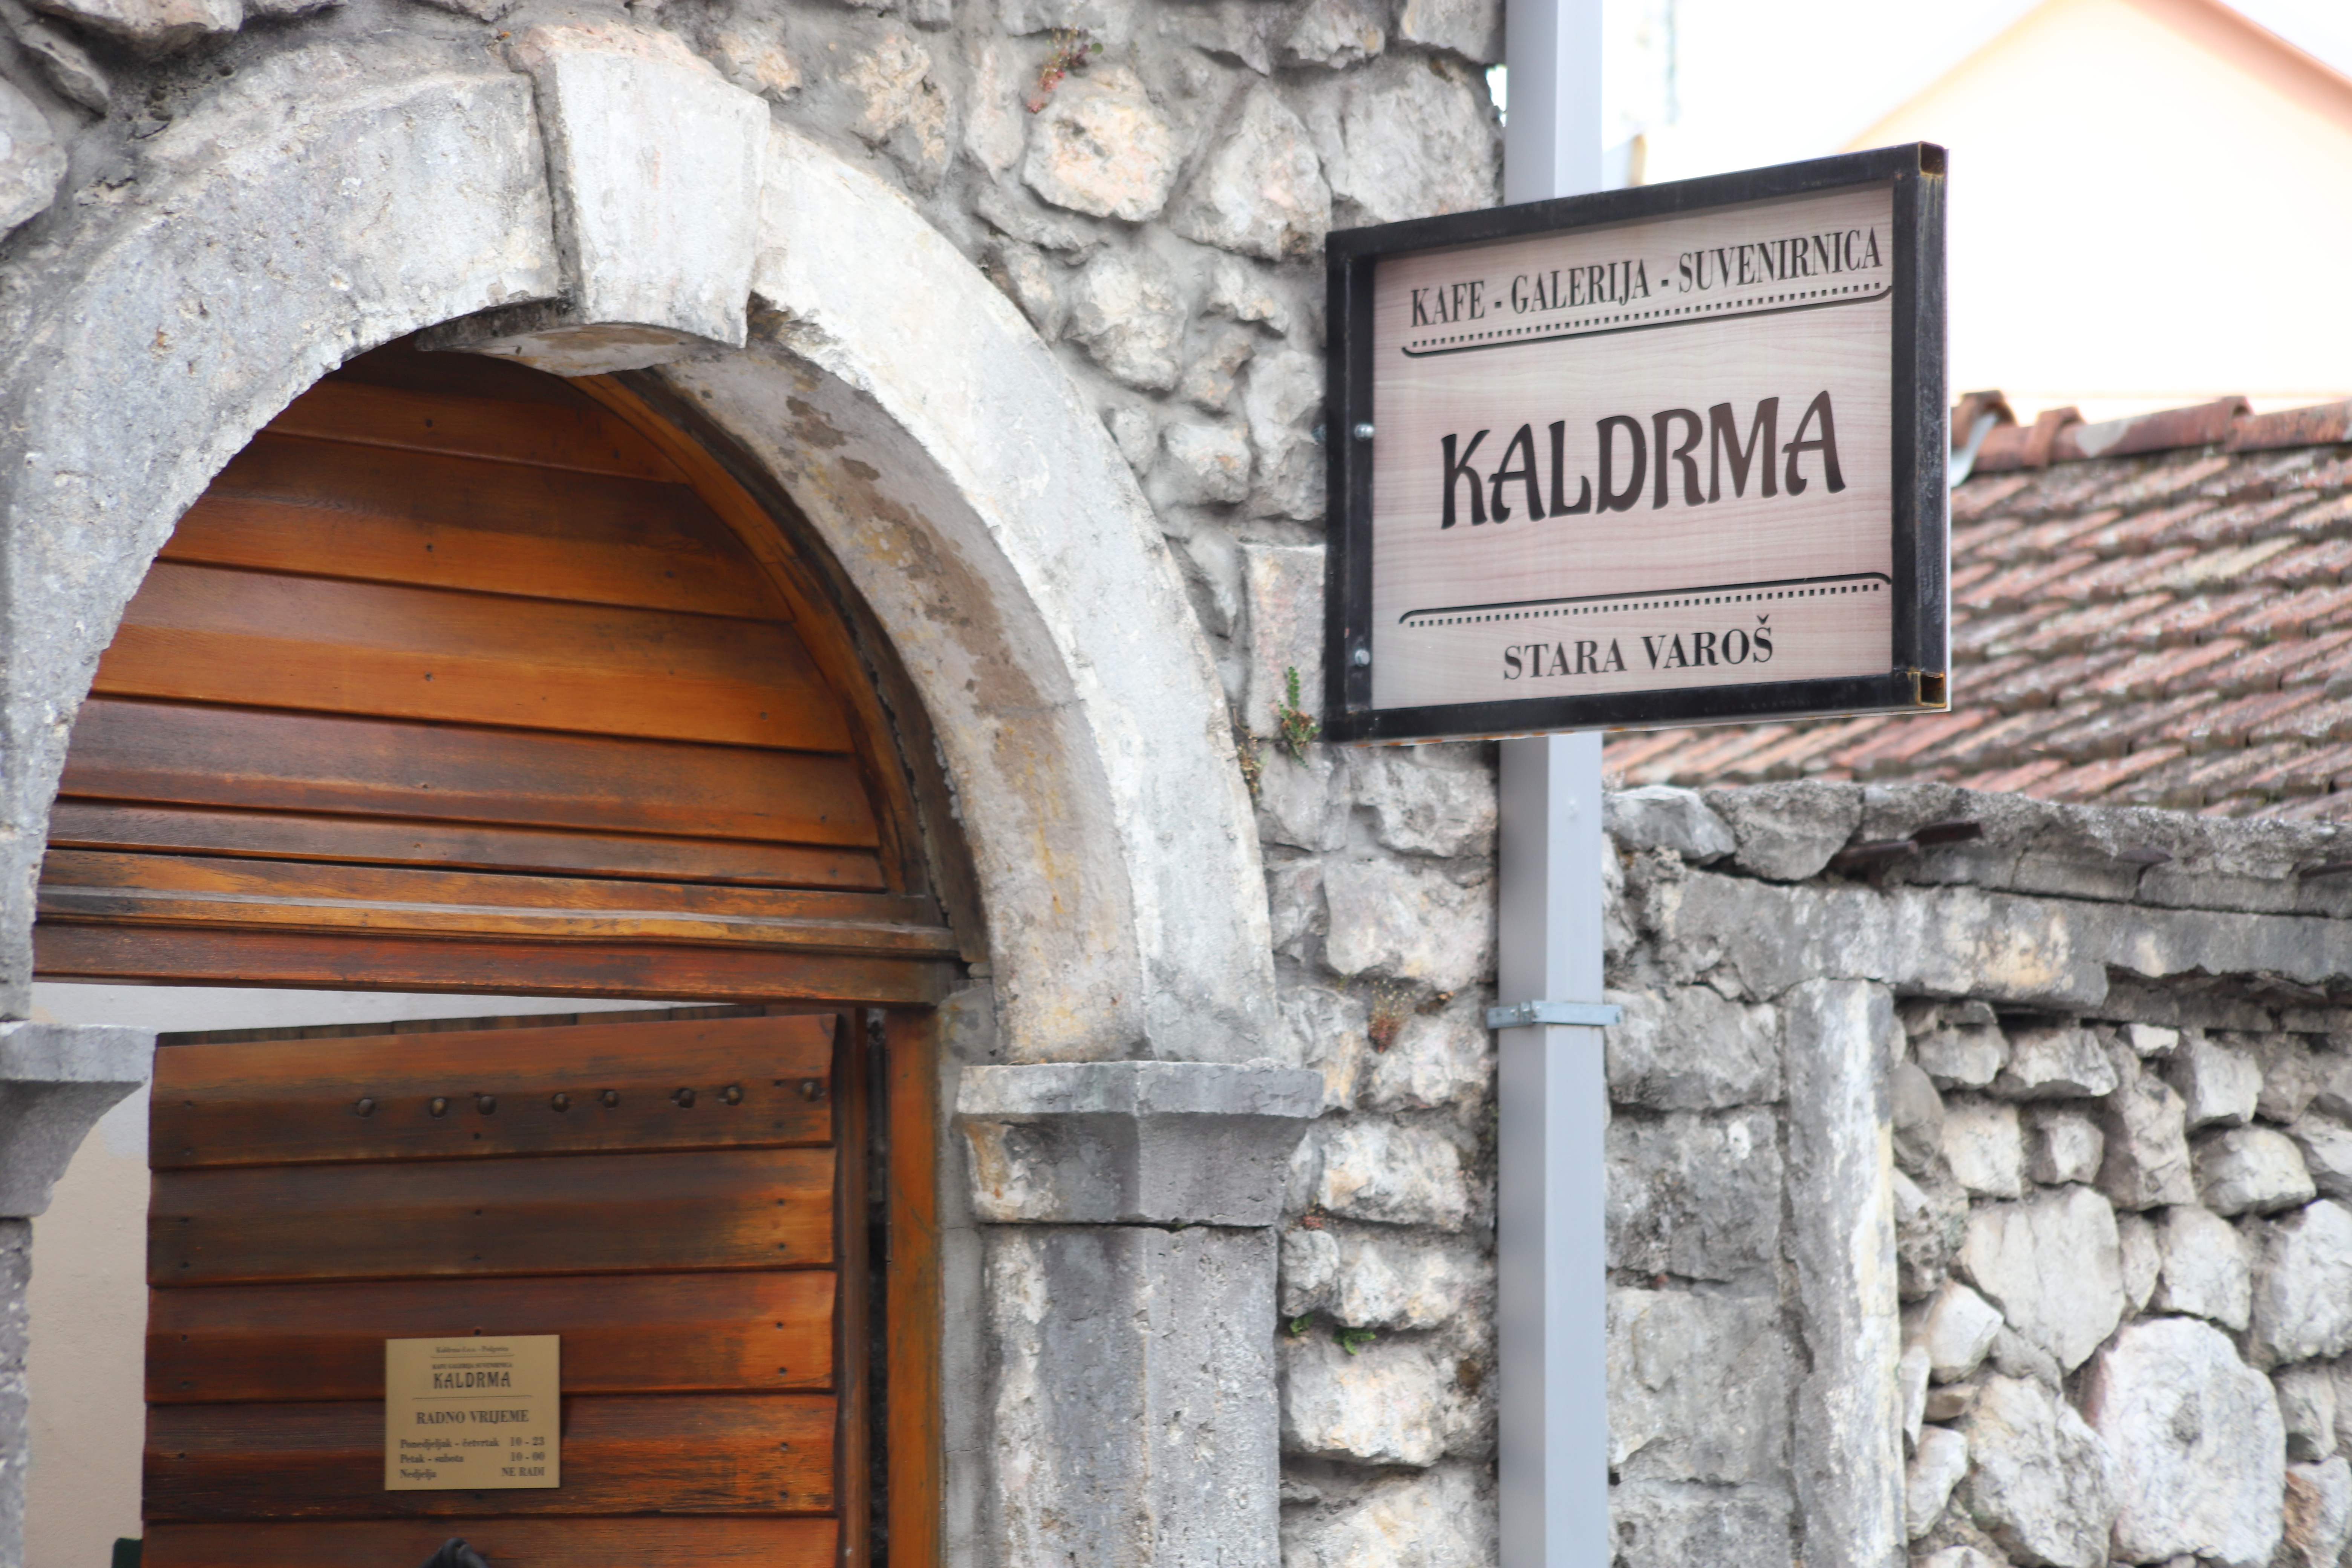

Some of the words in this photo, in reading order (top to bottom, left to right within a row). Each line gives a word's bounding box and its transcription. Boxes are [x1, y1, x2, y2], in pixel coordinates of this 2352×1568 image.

[1410, 281, 1485, 328] KAFE
[1511, 259, 1651, 314] GALERIJA
[1678, 227, 1883, 293] SUVENIRNICA
[1441, 390, 1846, 530] KALDRMA
[1504, 638, 1627, 680] STARA
[1641, 614, 1773, 669] VAROŠ
[433, 1371, 511, 1389] KALDRMA
[416, 1411, 466, 1424] RADNO
[469, 1410, 530, 1424] VRIJEME
[510, 1436, 522, 1446] 10
[532, 1436, 545, 1446] 23
[400, 1454, 425, 1463] Petak
[511, 1452, 523, 1461] 10
[501, 1467, 516, 1476] NE
[519, 1466, 545, 1476] RADI
